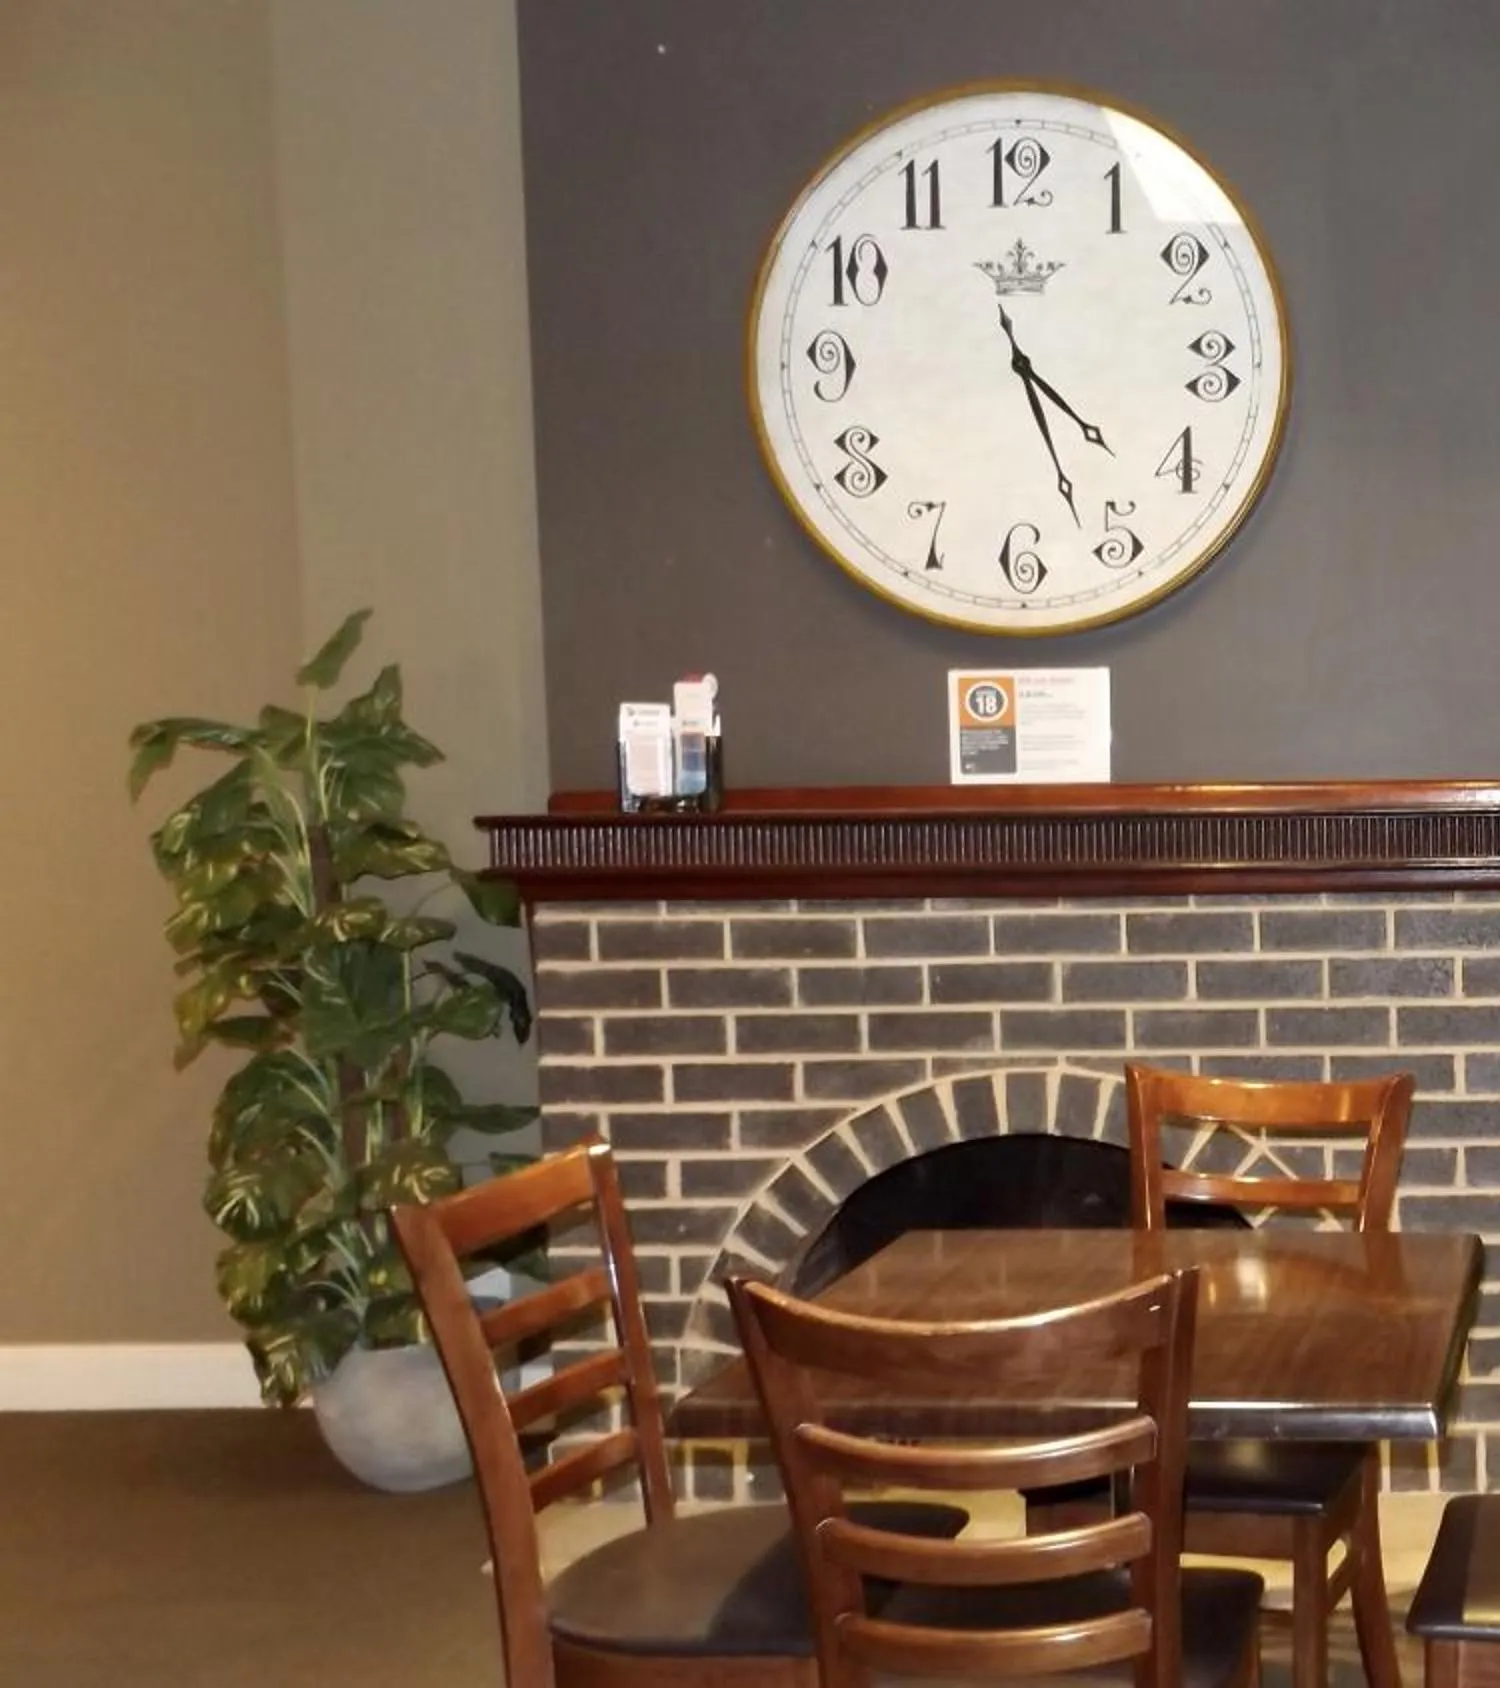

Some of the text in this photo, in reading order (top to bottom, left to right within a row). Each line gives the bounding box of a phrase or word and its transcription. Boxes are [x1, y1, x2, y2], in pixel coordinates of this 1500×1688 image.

[898, 159, 947, 229] 11
[986, 137, 1053, 207] 12
[1103, 162, 1127, 234] 1
[826, 234, 888, 307] 10
[1160, 232, 1212, 305] 2
[807, 330, 856, 402] 9
[1185, 330, 1241, 402] 3
[834, 426, 888, 497] 8
[1154, 426, 1202, 494] 4
[907, 501, 946, 570] 7
[999, 524, 1048, 594] 6
[1092, 501, 1144, 568] 5
[975, 695, 998, 716] 18
